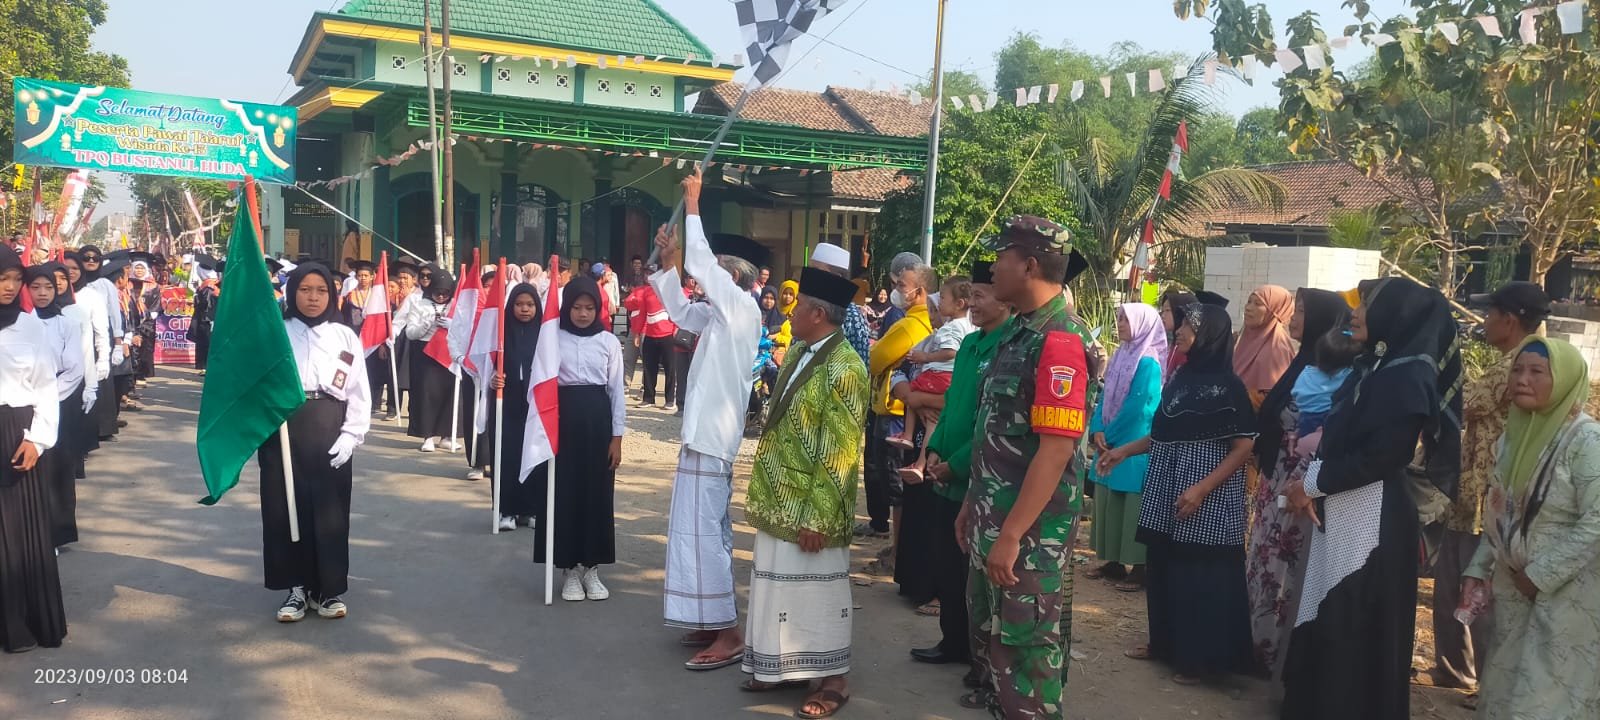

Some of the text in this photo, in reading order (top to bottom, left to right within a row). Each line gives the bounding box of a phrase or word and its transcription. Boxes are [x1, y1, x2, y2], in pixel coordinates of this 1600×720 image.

[97, 99, 224, 128] Selamat Datang
[77, 119, 139, 136] Peserta
[143, 125, 188, 142] Pawai
[117, 136, 169, 152] Wisuda
[74, 150, 247, 176] TPQ BUSTANUL HUDA
[1031, 406, 1083, 431] BABINSA
